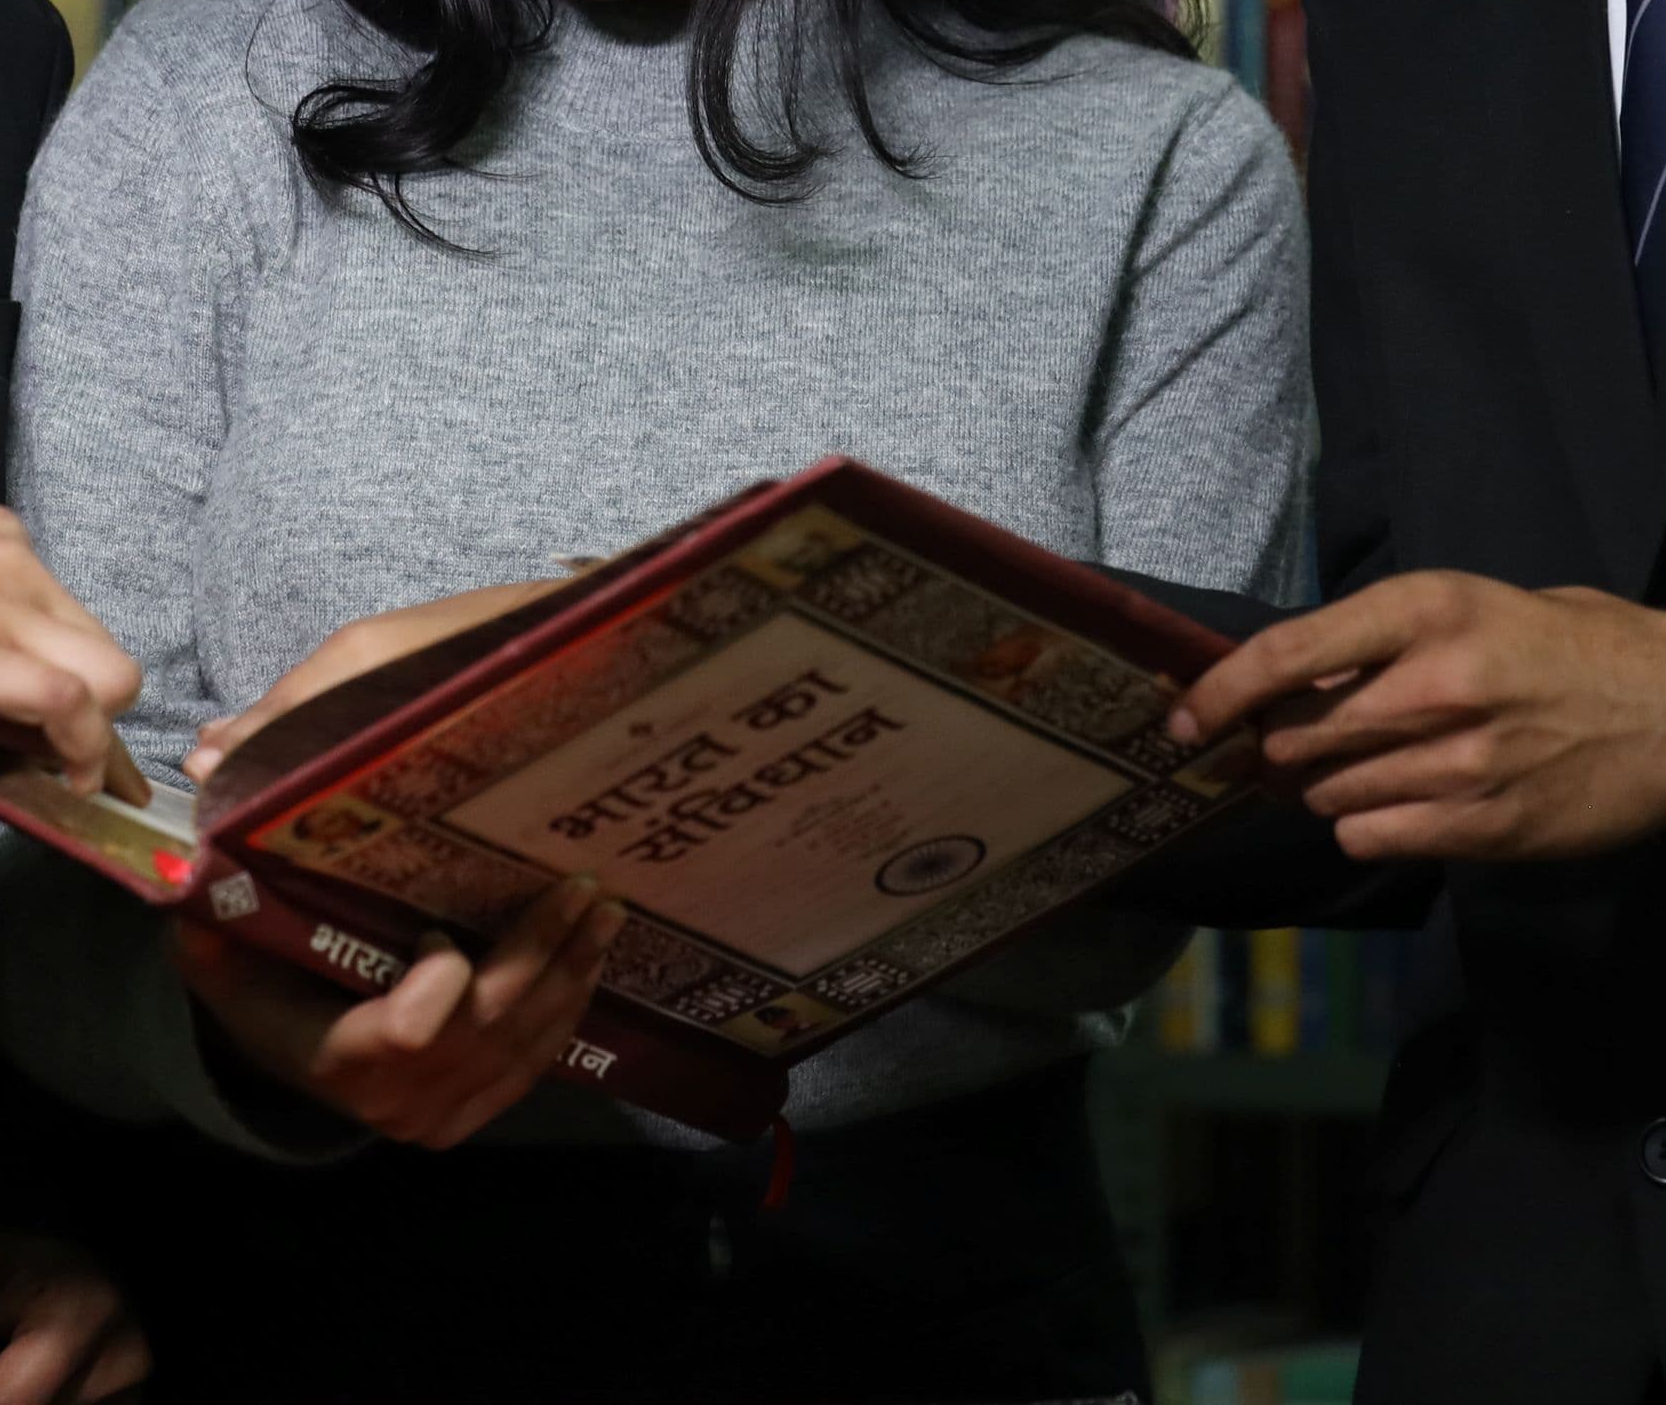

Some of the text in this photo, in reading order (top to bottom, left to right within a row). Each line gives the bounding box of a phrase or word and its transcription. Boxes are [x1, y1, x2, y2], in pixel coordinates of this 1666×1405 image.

[549, 731, 740, 839] भारत
[732, 667, 850, 731] का
[618, 705, 908, 863] संविधान
